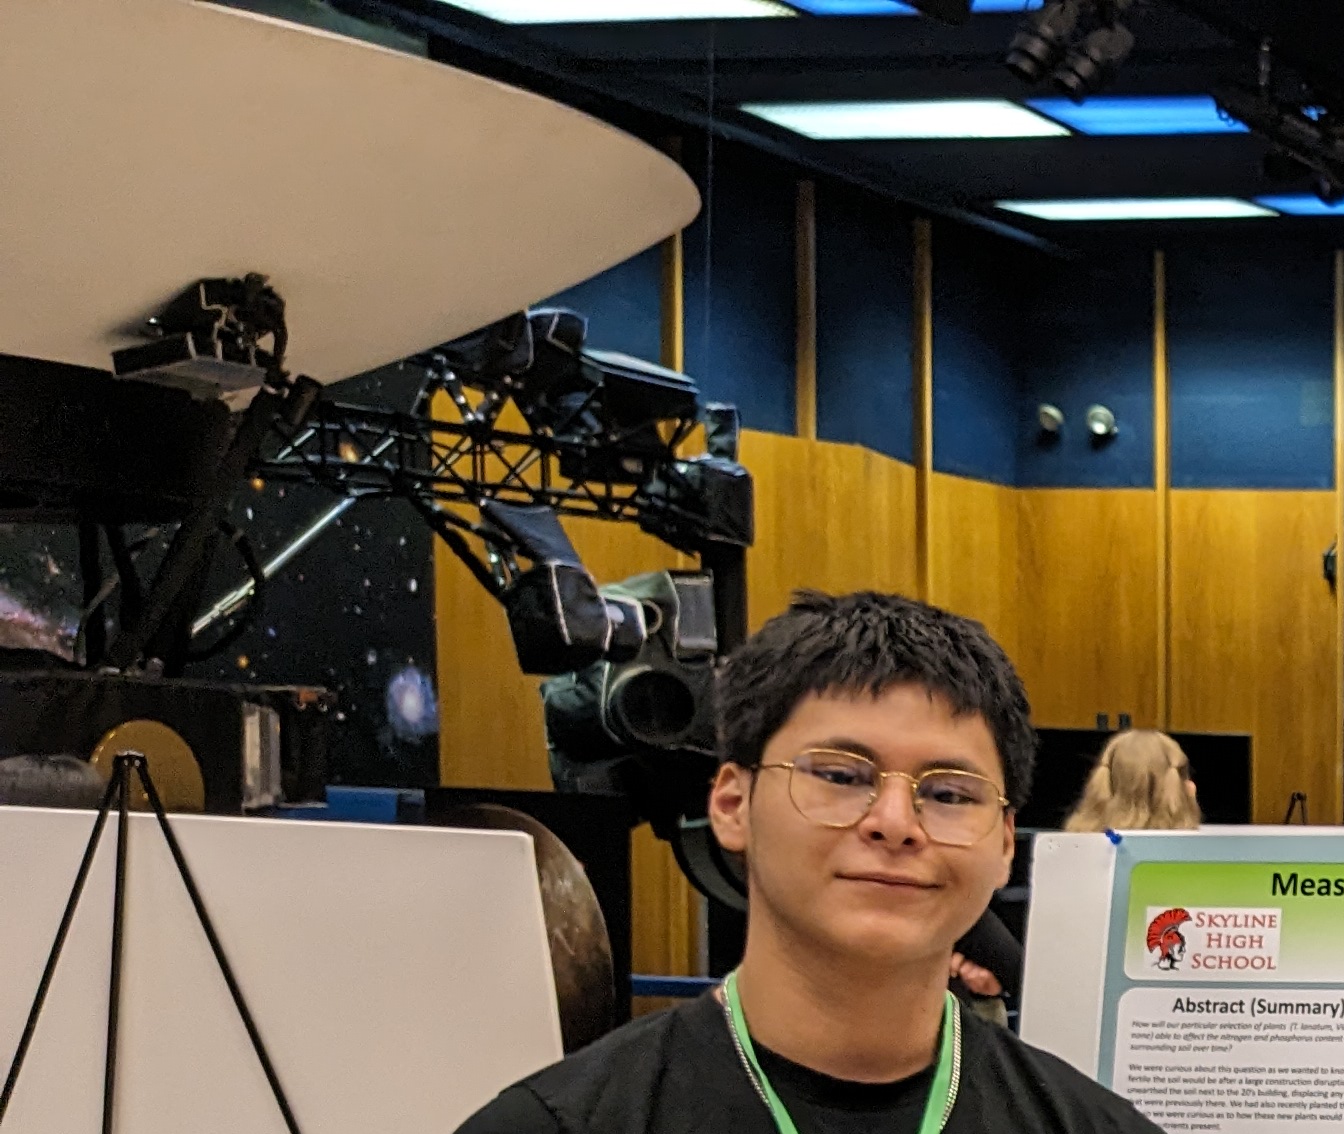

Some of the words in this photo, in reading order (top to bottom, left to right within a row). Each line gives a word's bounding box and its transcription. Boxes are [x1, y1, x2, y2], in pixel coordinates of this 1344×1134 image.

[1194, 911, 1282, 931] SKYLINE
[1206, 932, 1263, 949] HIGH
[1191, 952, 1276, 970] SCHOOL
[1172, 997, 1245, 1013] Abstract
[1250, 997, 1344, 1018] (Summary)
